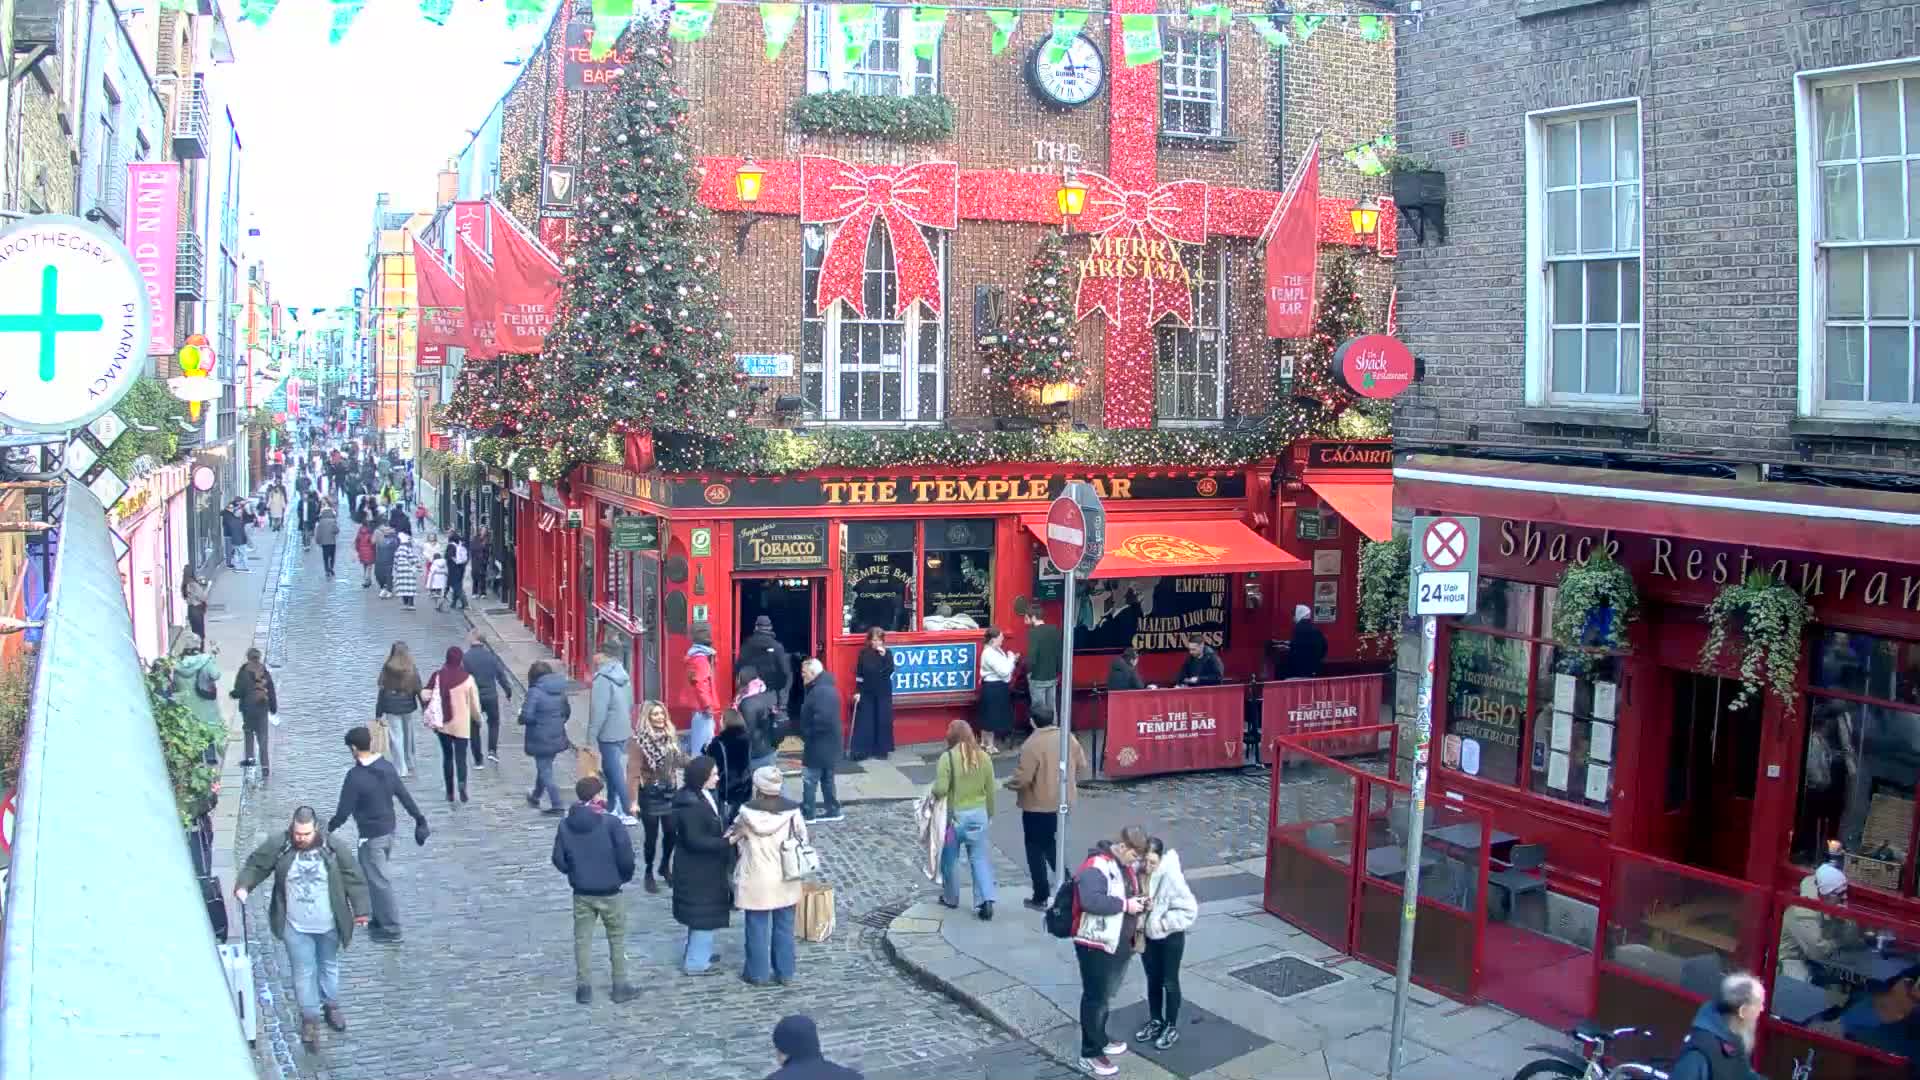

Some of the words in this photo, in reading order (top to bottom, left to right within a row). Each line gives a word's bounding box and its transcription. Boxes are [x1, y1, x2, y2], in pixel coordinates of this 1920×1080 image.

[568, 47, 634, 63] TEPLE
[1032, 141, 1081, 162] THE
[137, 171, 167, 232] NINE
[1089, 237, 1184, 262] MERRY
[1080, 259, 1204, 287] HRISTMAS
[1271, 286, 1308, 301] TEMPL
[519, 303, 545, 313] THE
[1279, 303, 1303, 315] BAR
[502, 313, 556, 324] TEMPL
[516, 326, 548, 336] BAR
[88, 303, 135, 400] PHARMACY
[636, 477, 652, 499] BAR
[709, 487, 726, 500] 48
[822, 481, 897, 504] THE
[912, 479, 1050, 503] TEMPLE
[1066, 478, 1132, 499] AR
[748, 538, 816, 562] TOBACCO
[1500, 519, 1620, 567] Shack
[873, 555, 889, 563] THE
[848, 565, 891, 586] TEMPLE
[1175, 578, 1225, 593] EMPEROR
[1421, 583, 1442, 603] 24
[1211, 593, 1224, 607] OF
[1443, 593, 1465, 602] HOUR
[1136, 616, 1180, 632] MALTED
[1183, 608, 1225, 628] LIQUORS
[1131, 631, 1225, 650] GUINNSS
[892, 647, 968, 666] OWER'S
[1316, 701, 1333, 709] THE
[1168, 711, 1188, 721] THE
[1288, 709, 1333, 722] TEMPLE
[1335, 706, 1358, 718] BAR
[1136, 720, 1188, 734] TEMPLE
[1191, 718, 1217, 730] BAR
